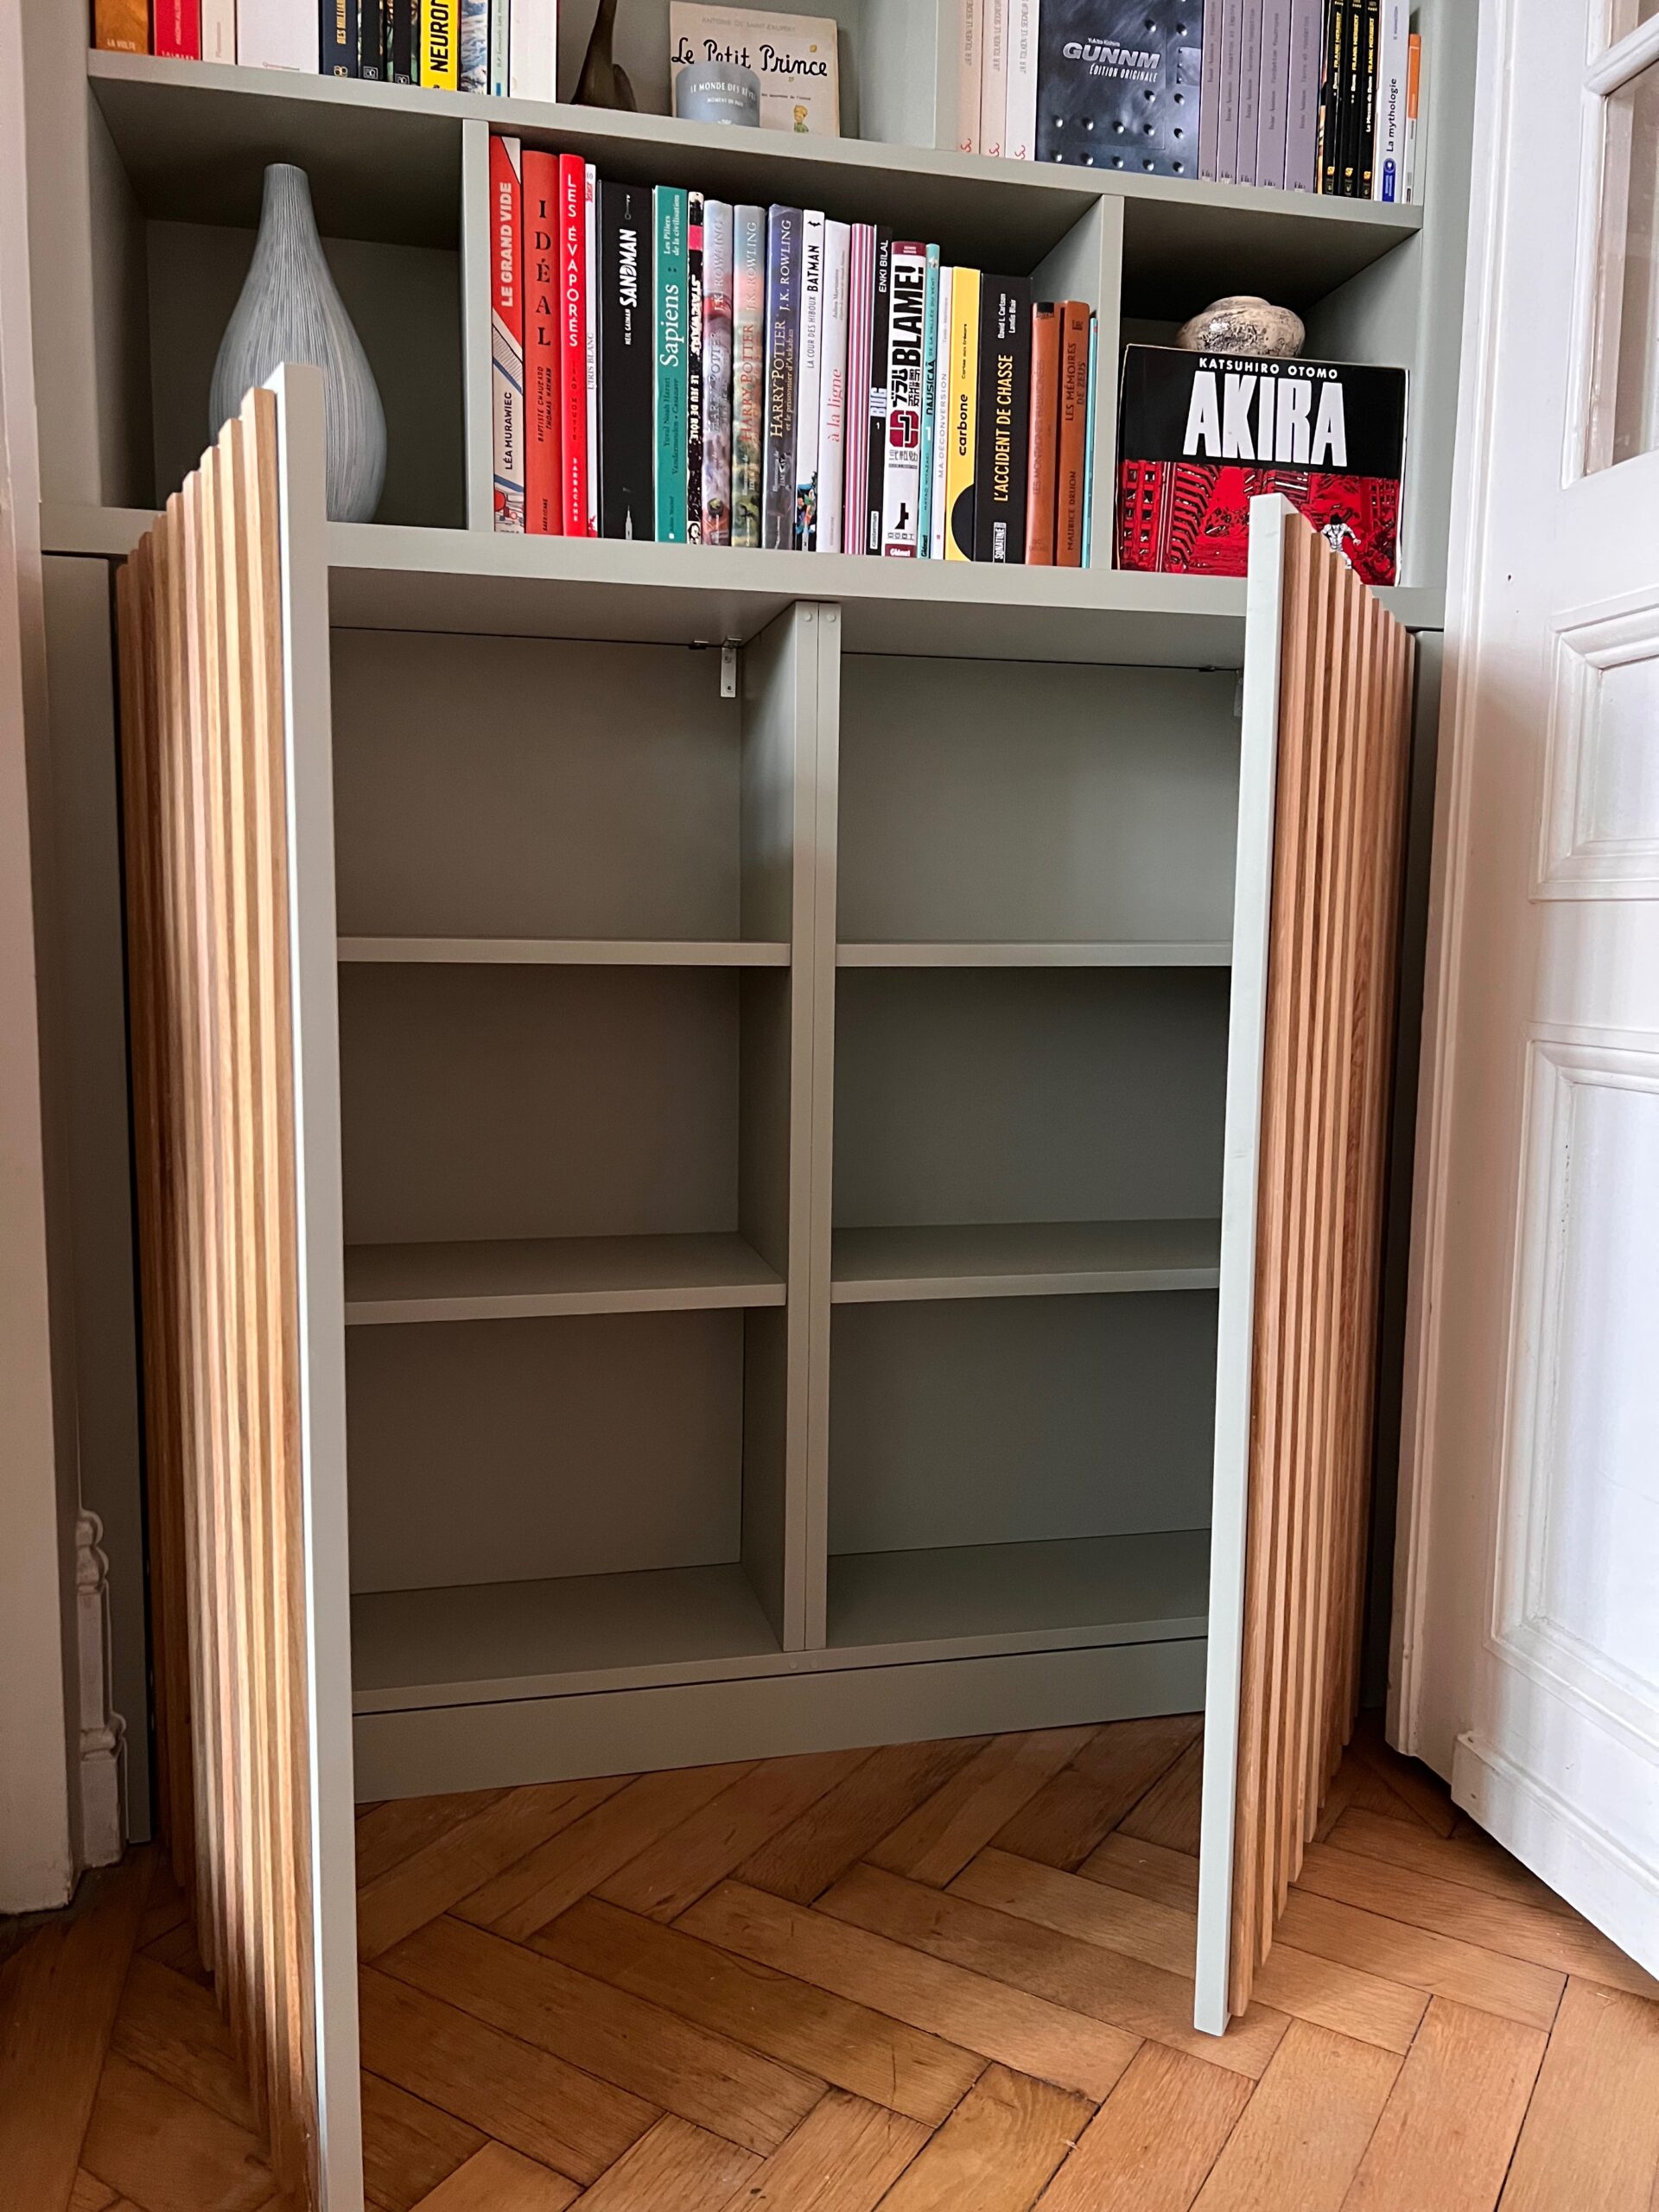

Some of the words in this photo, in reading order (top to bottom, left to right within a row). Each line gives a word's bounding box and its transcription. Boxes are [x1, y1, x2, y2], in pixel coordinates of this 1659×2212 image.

[671, 37, 695, 65] Le
[759, 44, 828, 77] Prince
[1063, 42, 1160, 69] GUNNM
[698, 82, 725, 92] MONDE
[1090, 62, 1119, 78] ÉDITION
[1120, 69, 1159, 83] ORIGINALE
[1388, 79, 1398, 137] mythologie
[1387, 141, 1395, 152] La
[499, 181, 512, 222] VIDE
[568, 174, 577, 217] LES
[499, 225, 513, 283] GRAND
[672, 238, 680, 246] la
[672, 246, 680, 256] de
[712, 221, 724, 287] ROWLING
[747, 222, 757, 284] ROWLING
[779, 220, 791, 285] ROWLING
[879, 240, 888, 267] BILAL
[535, 200, 551, 346] IDÉAL
[619, 229, 637, 308] SANDMAN
[806, 245, 820, 293] BATMAN
[878, 269, 887, 293] ENKI
[500, 286, 513, 308] LE
[567, 225, 580, 346] ÉVAPORÉS
[691, 275, 702, 313] STAR
[808, 296, 817, 323] HIBOUX
[892, 265, 924, 367] BLAME!
[659, 284, 685, 367] Sapiens
[807, 325, 816, 338] DES
[997, 323, 1006, 339] David
[587, 332, 595, 364] BLANC
[740, 324, 753, 384] POTTER
[771, 321, 786, 380] POTTER
[806, 340, 815, 358] COUR
[587, 365, 595, 391] L'IRIS
[690, 375, 700, 384] LE
[806, 360, 815, 369] LA
[996, 354, 1014, 405] CHASSE
[1064, 342, 1077, 401] MÉMOIRES
[1076, 361, 1085, 388] ZEUS
[1199, 357, 1280, 374] KATSUHIRO
[1287, 365, 1338, 379] OTOMO
[690, 386, 700, 402] JEU
[827, 369, 842, 409] ligne
[870, 387, 887, 417] BUG
[503, 392, 513, 448] MURAWIEC
[690, 404, 699, 416] DE
[740, 386, 753, 442] HARRY
[770, 380, 784, 438] HARRY
[827, 415, 840, 428] la
[938, 373, 947, 460] DÉCONVERSION
[995, 409, 1012, 425] DE
[1065, 404, 1075, 422] LES
[1182, 370, 1348, 467] AKIRA
[662, 427, 671, 447] Yuval
[690, 417, 701, 441] RÔLE
[827, 434, 840, 442] à
[957, 394, 968, 456] carbone
[502, 450, 513, 471] LÉA
[938, 462, 945, 479] MA
[994, 429, 1011, 502] L'ACCIDENT
[995, 527, 1006, 560] SONATINE
